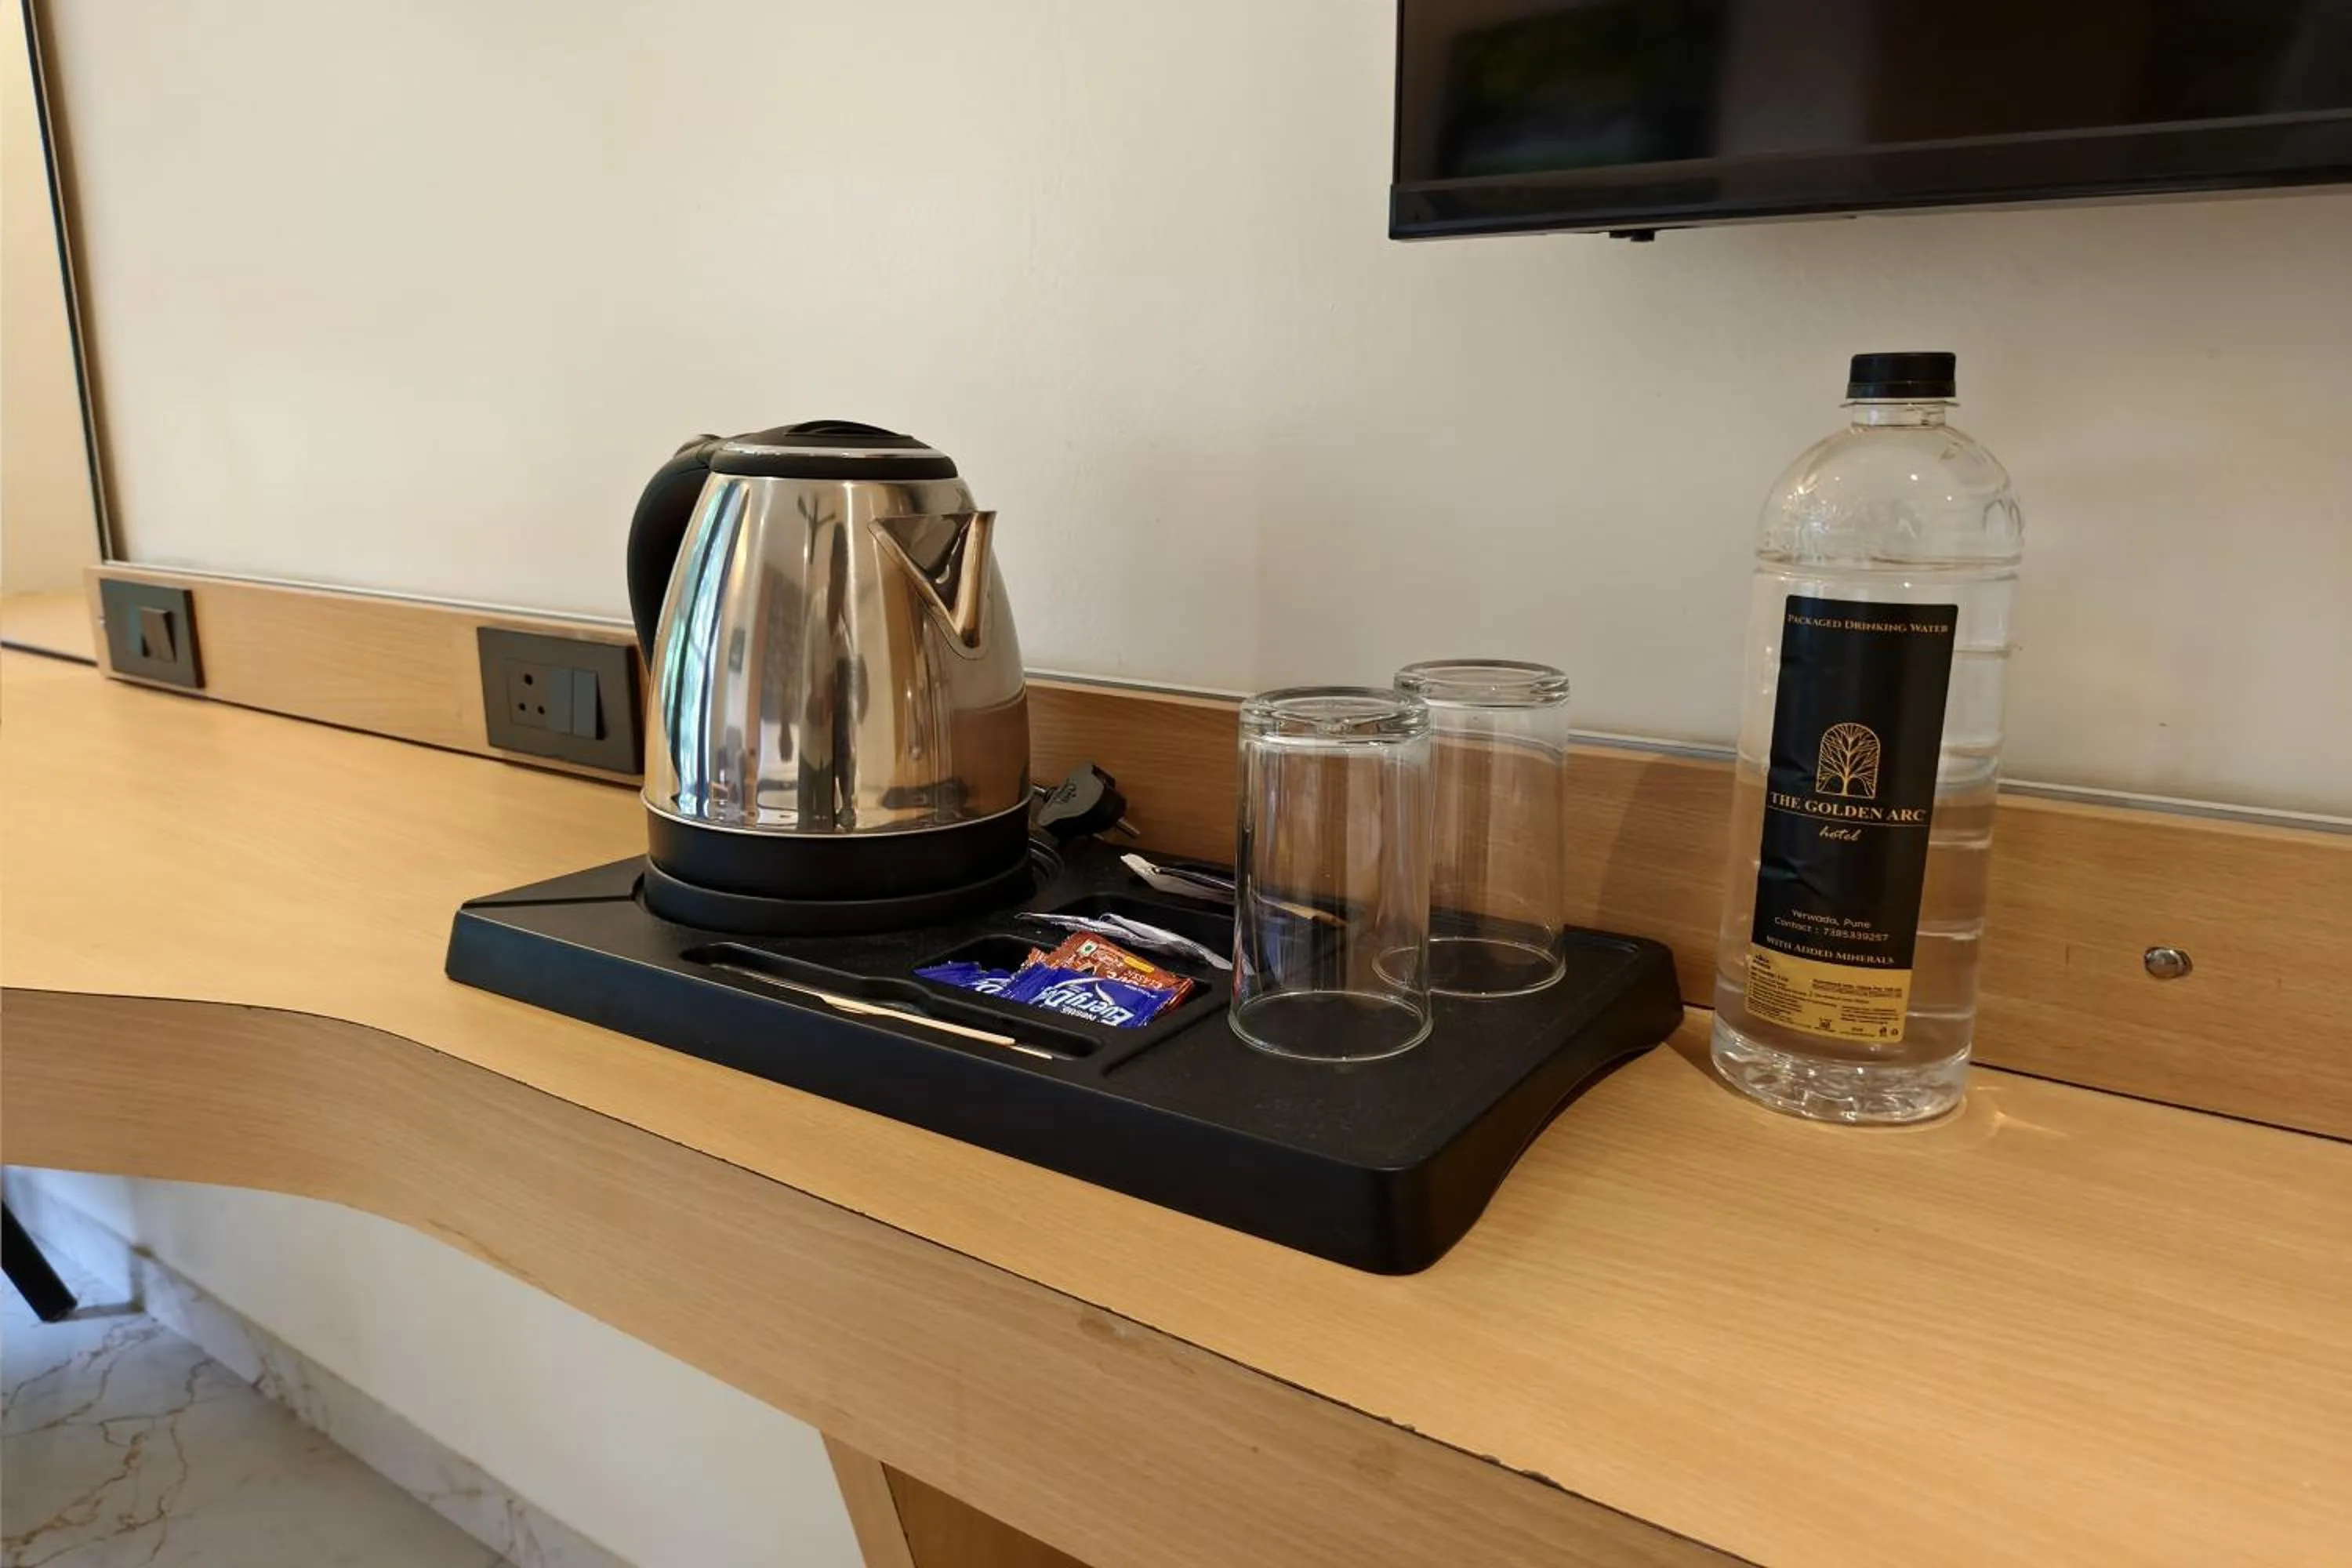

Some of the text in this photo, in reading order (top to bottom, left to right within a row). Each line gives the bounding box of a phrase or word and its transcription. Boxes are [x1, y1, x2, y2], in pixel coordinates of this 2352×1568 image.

[1788, 614, 1949, 633] PACKAGED DRINKING WATER
[1769, 791, 1927, 822] THE GOLDEN ARC
[1818, 825, 1863, 841] hotel
[1773, 916, 1813, 934] Contact
[1843, 917, 1872, 929] Pune
[1766, 935, 1896, 965] WITH ADDED MINERALS
